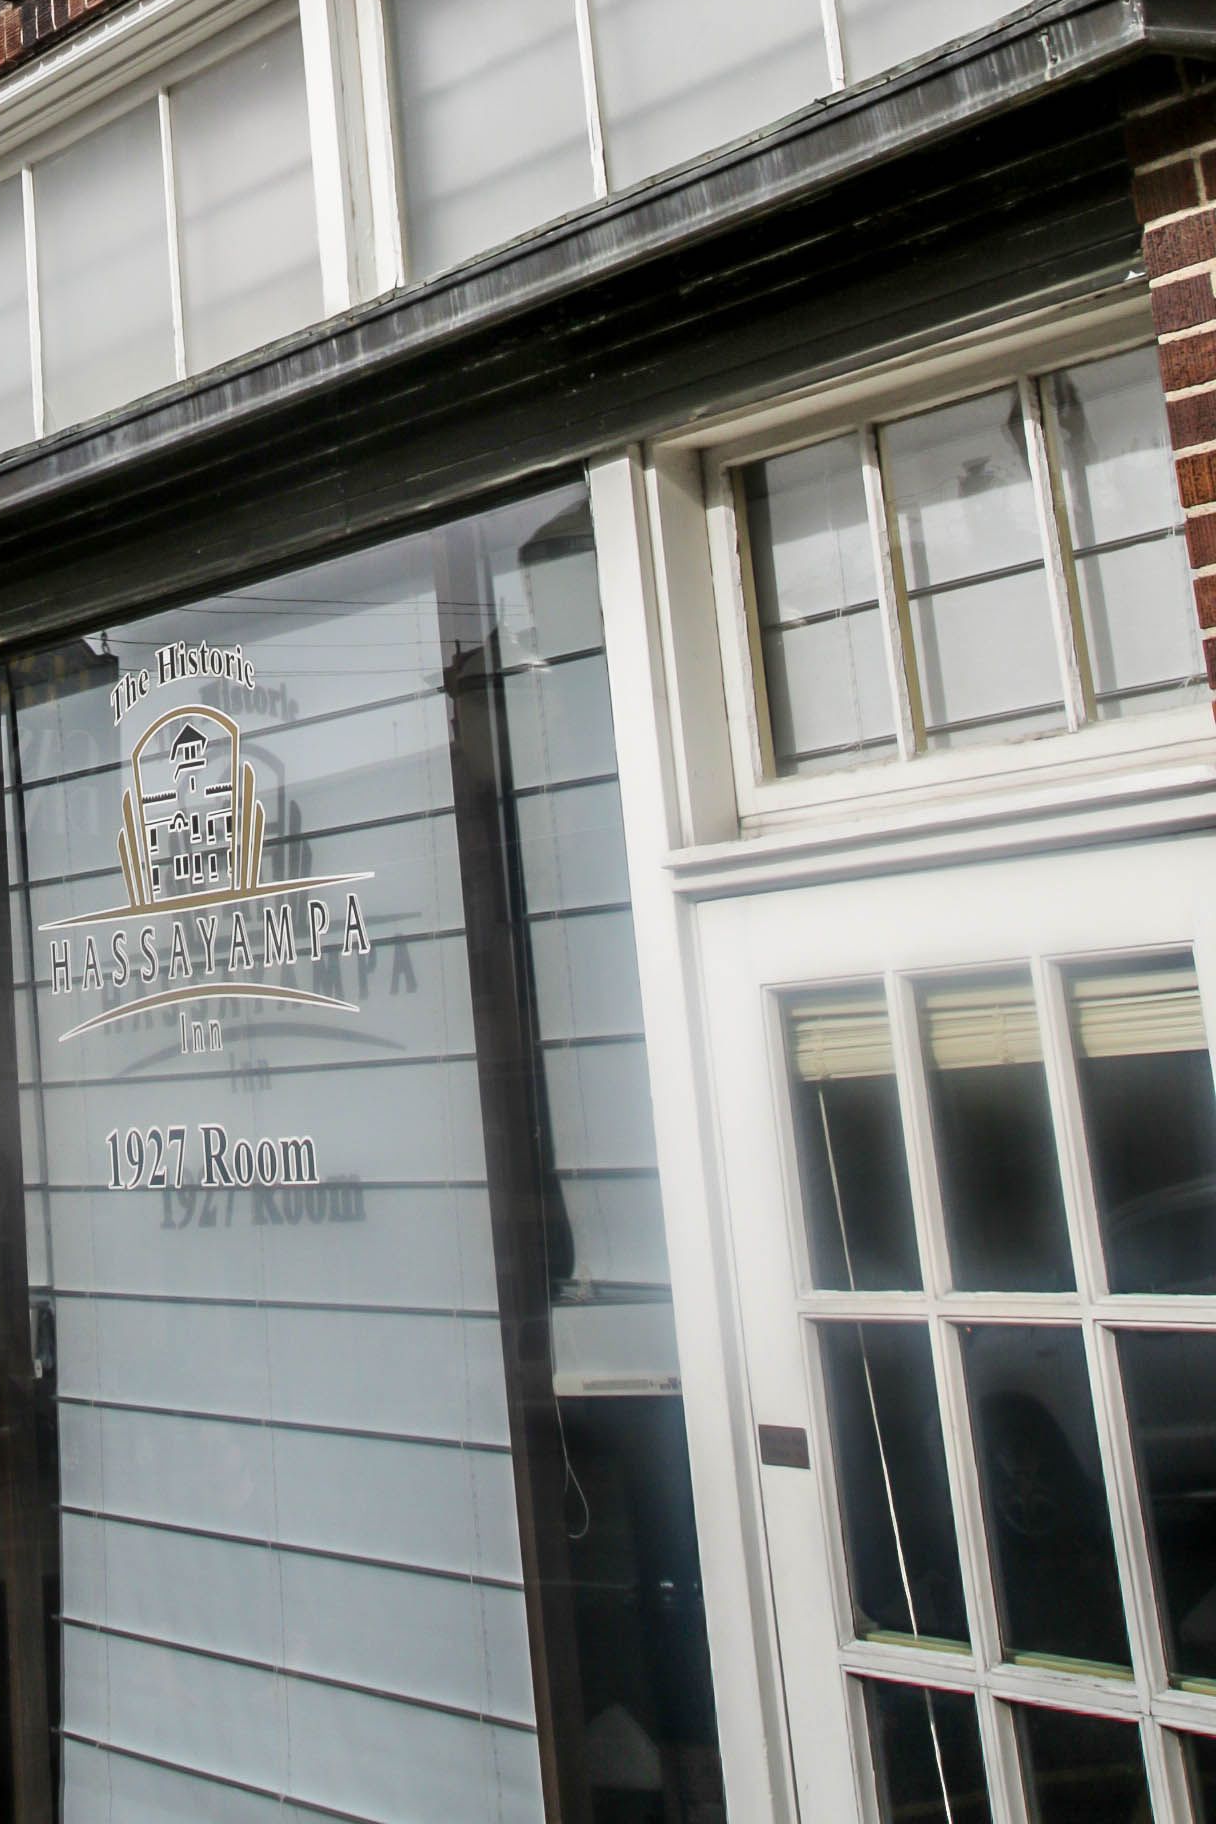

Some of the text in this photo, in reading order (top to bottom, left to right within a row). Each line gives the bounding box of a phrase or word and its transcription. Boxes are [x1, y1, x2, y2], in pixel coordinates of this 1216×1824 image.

[110, 639, 255, 726] The Historic
[49, 892, 371, 994] HASSAYAMPA
[179, 1012, 224, 1053] Inn
[104, 1122, 319, 1190] 1927 Room
